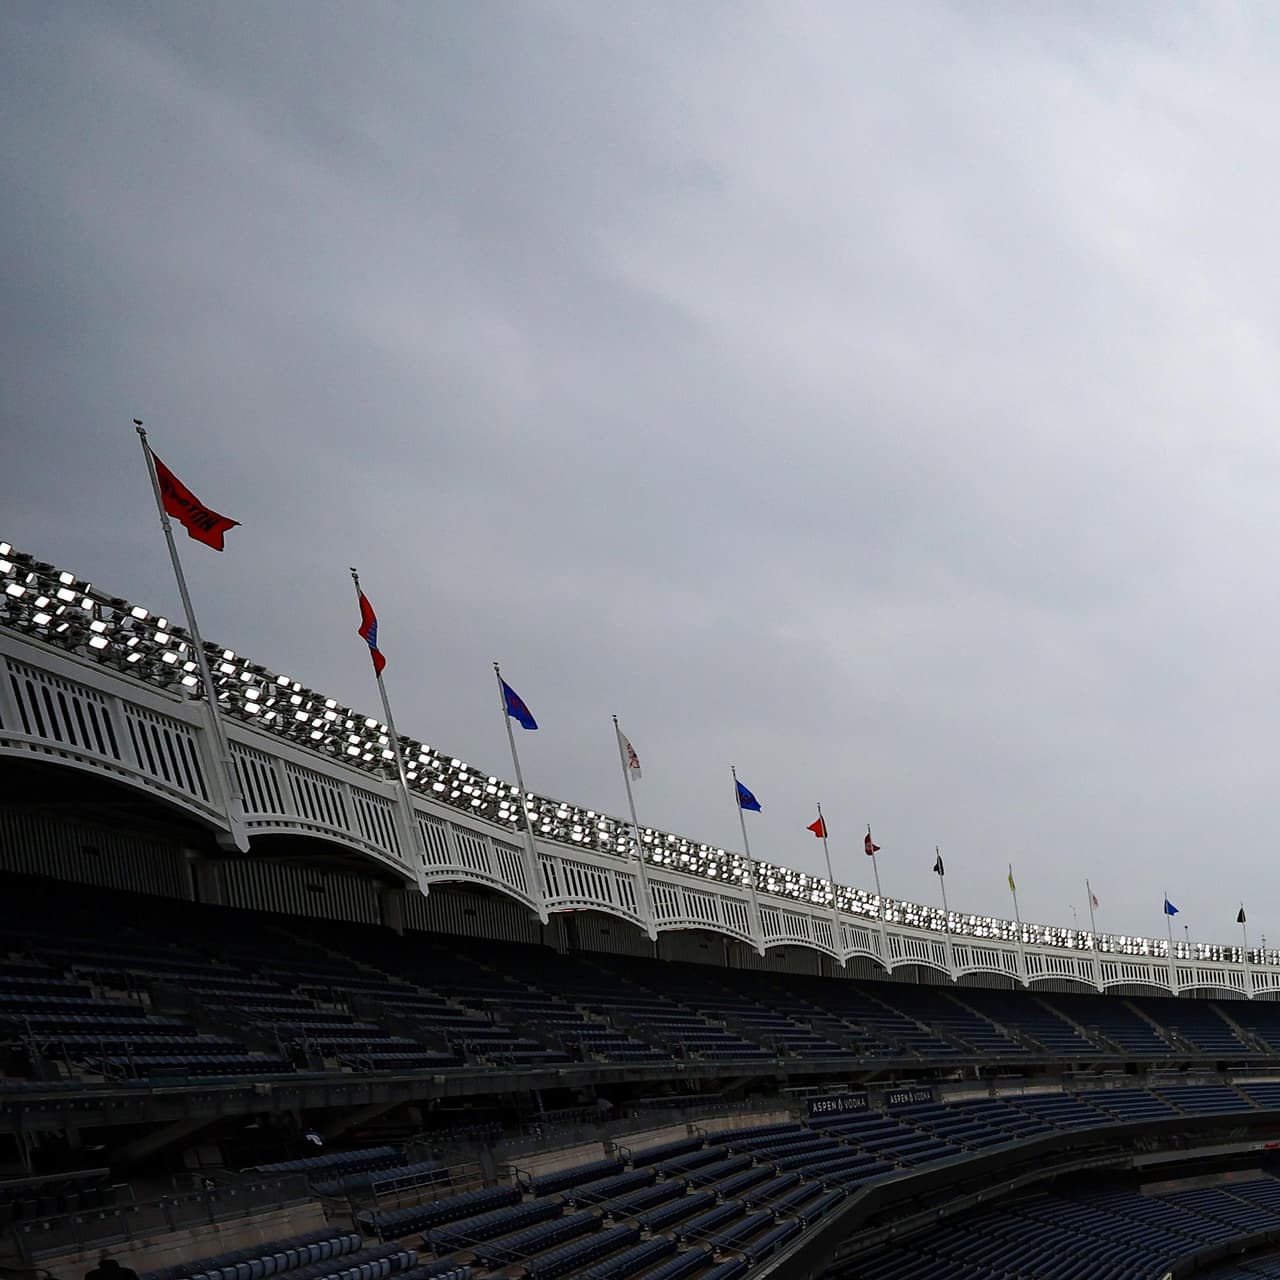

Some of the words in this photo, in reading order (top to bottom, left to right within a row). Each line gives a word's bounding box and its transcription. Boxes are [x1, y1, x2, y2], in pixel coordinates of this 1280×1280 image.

[890, 1093, 908, 1104] ASPEN
[813, 1101, 837, 1113] ASPEN
[844, 1098, 867, 1110] VODKA
